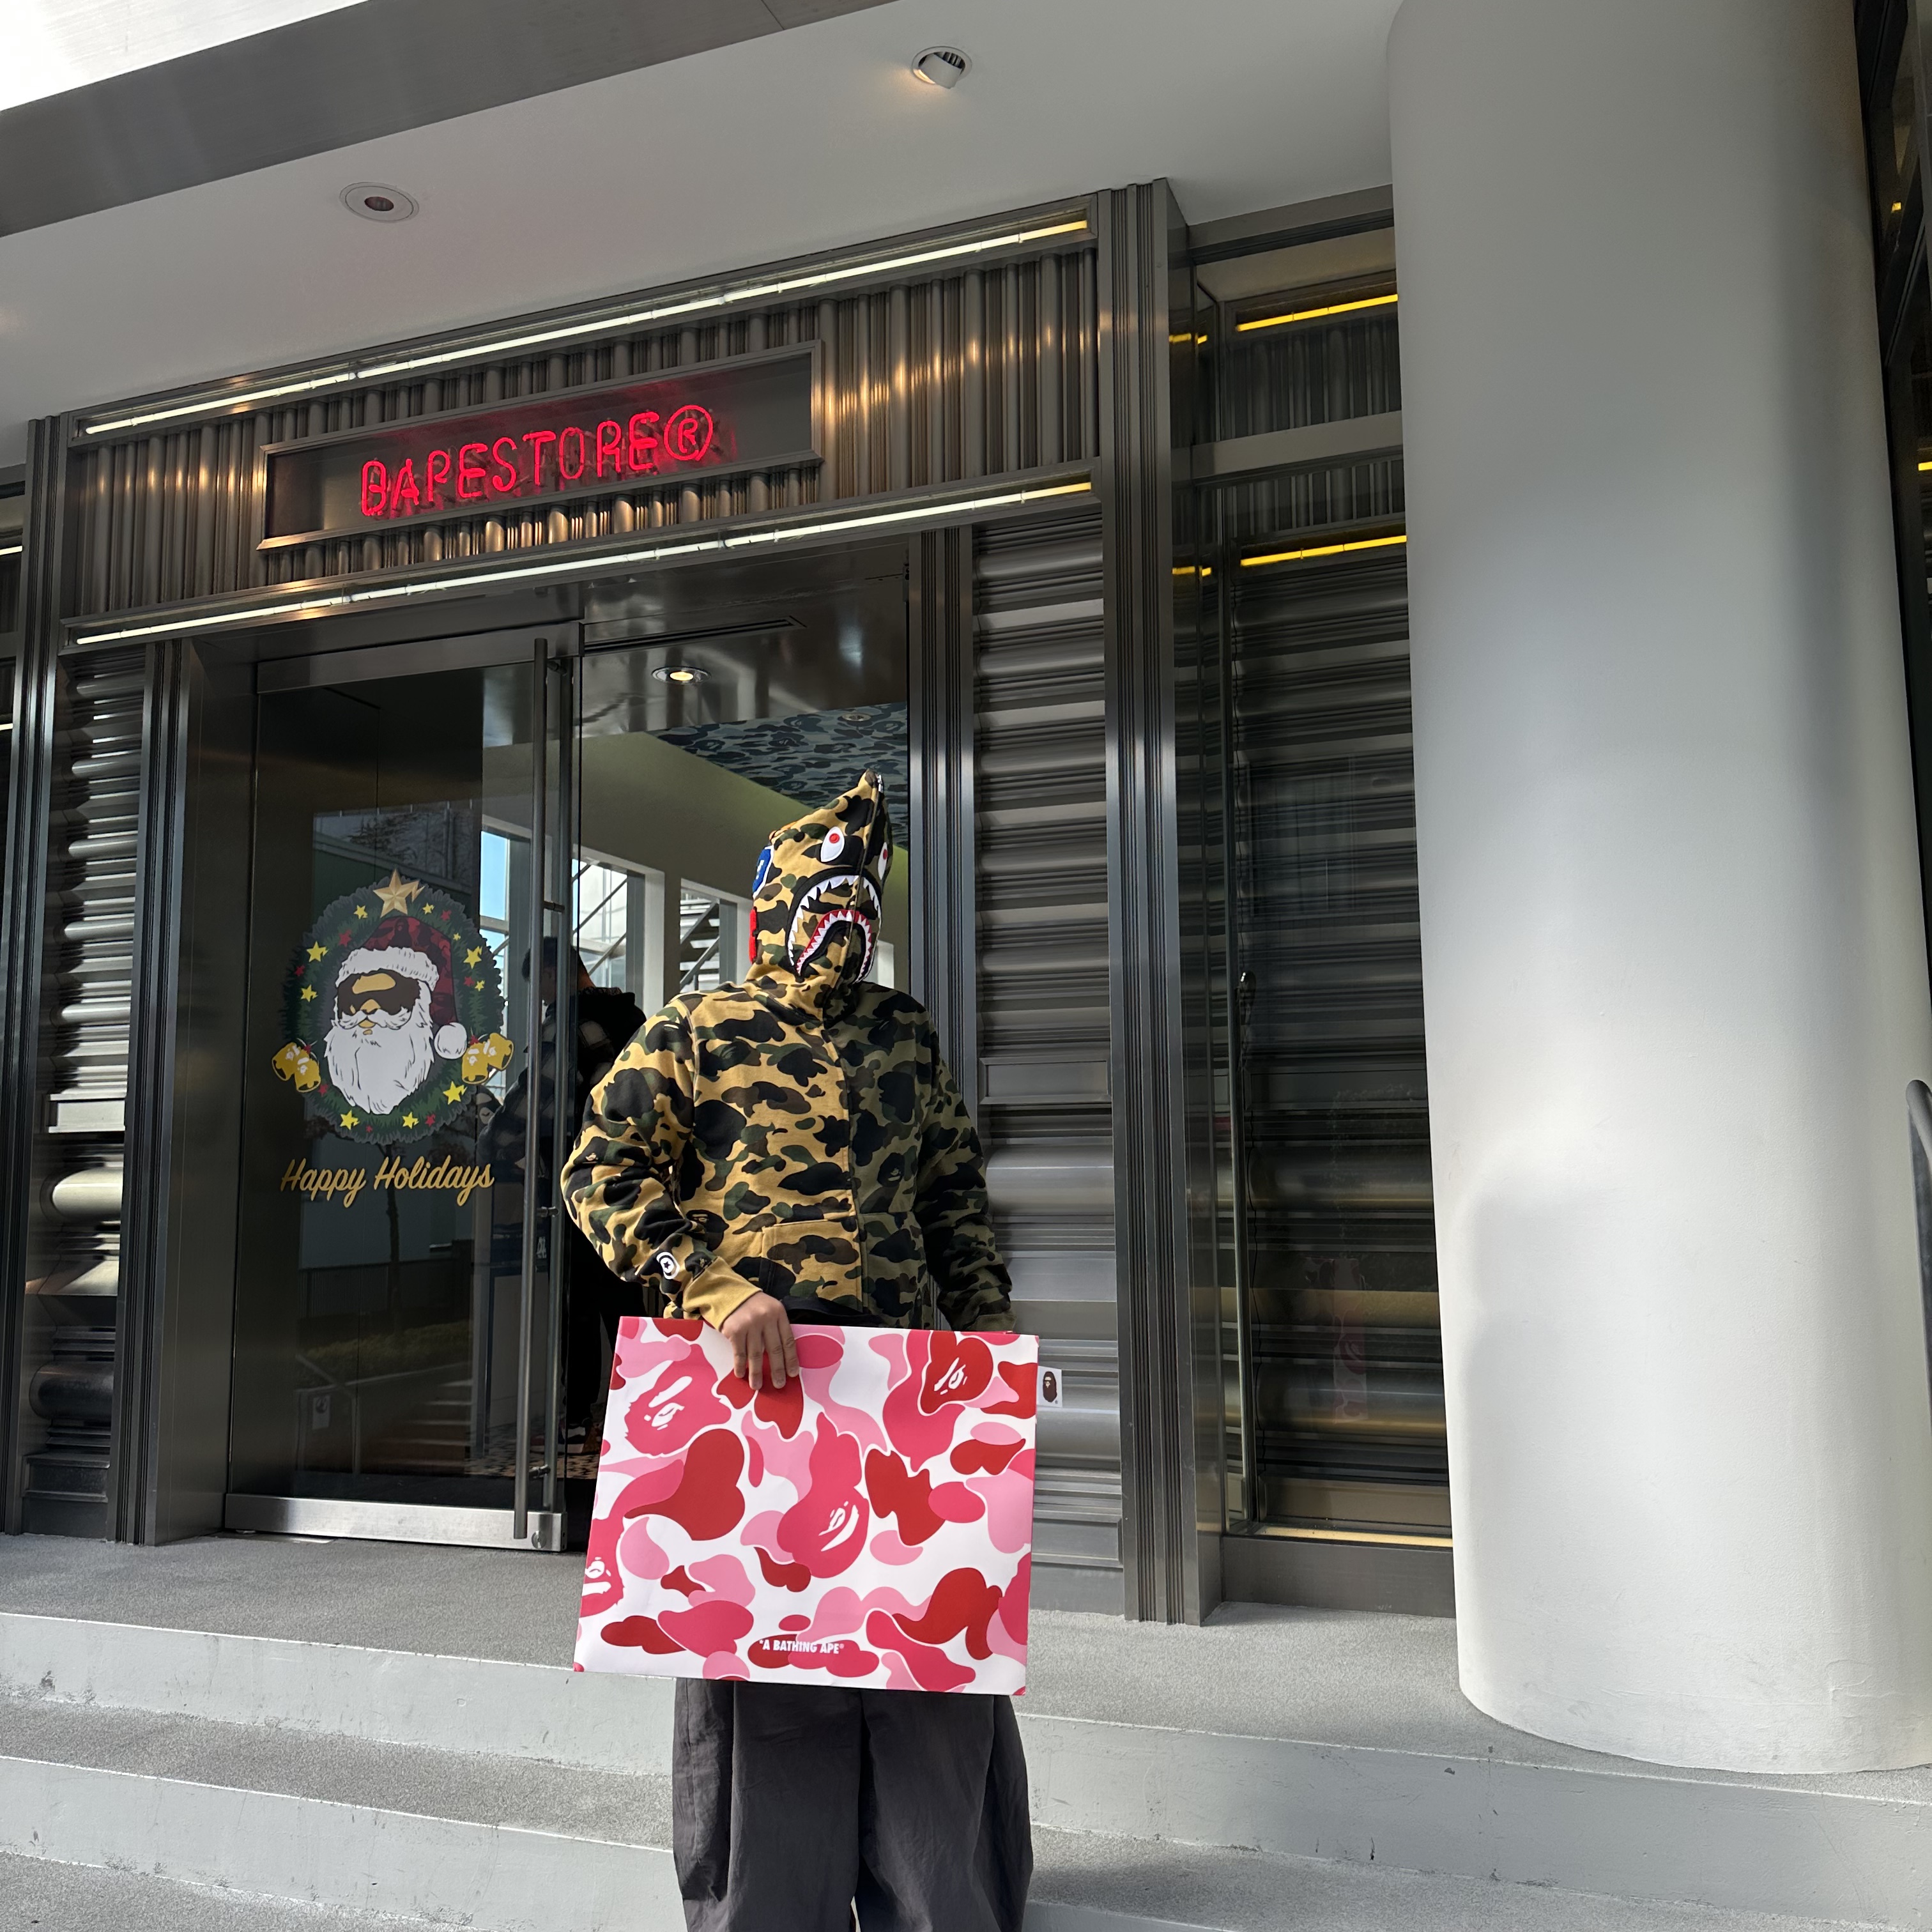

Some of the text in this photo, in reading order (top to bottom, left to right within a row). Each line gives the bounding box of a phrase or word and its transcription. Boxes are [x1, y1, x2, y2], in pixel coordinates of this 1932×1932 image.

[280, 1155, 494, 1208] Happy Holidays
[773, 1640, 817, 1653] BATHING
